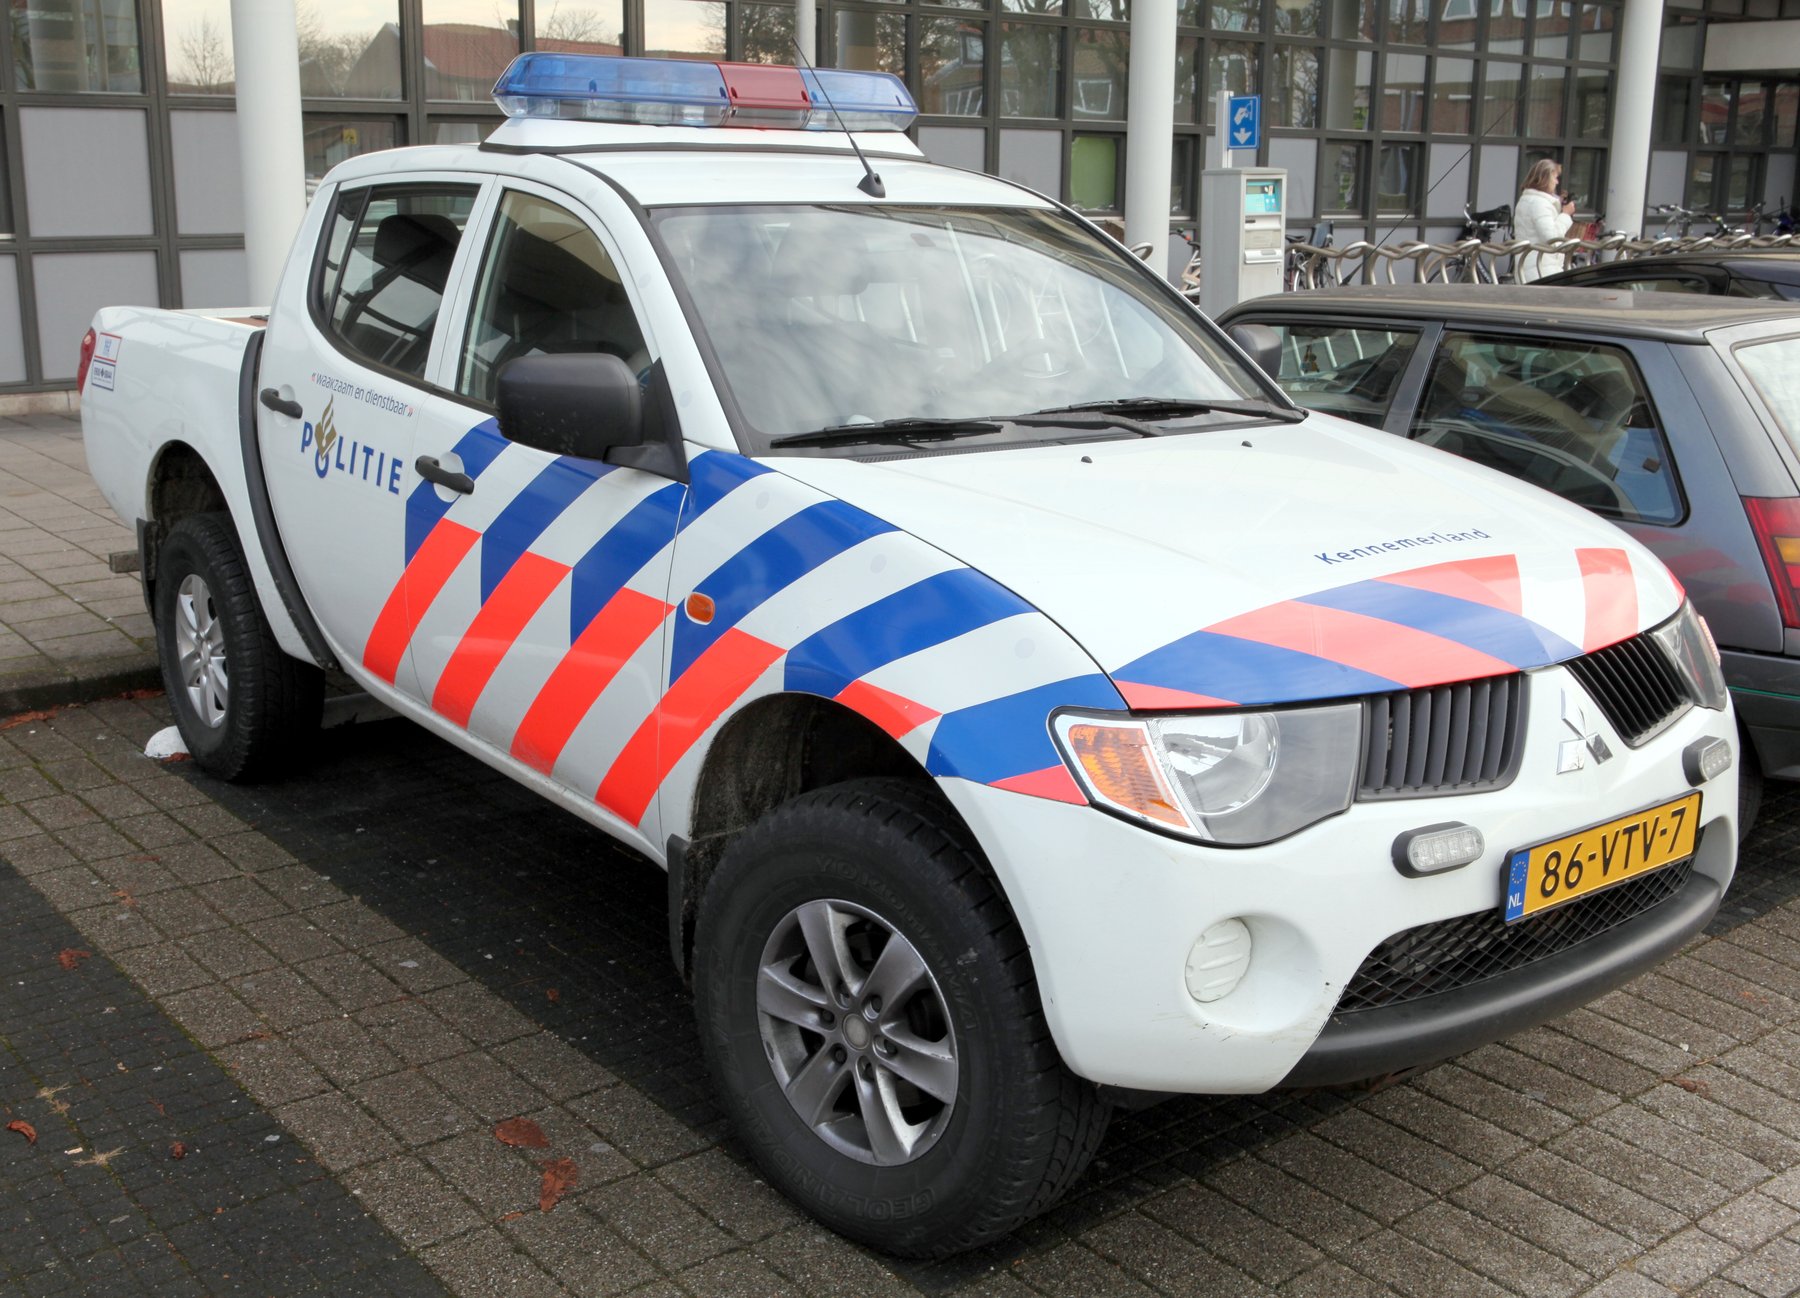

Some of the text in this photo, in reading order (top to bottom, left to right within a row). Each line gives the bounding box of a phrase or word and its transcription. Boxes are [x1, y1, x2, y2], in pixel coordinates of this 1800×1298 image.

[354, 387, 365, 401] en
[301, 421, 404, 495] POLITIE
[1313, 528, 1492, 565] Kennemerland
[1540, 805, 1687, 898] 86-VTV-7
[1507, 892, 1523, 910] NL
